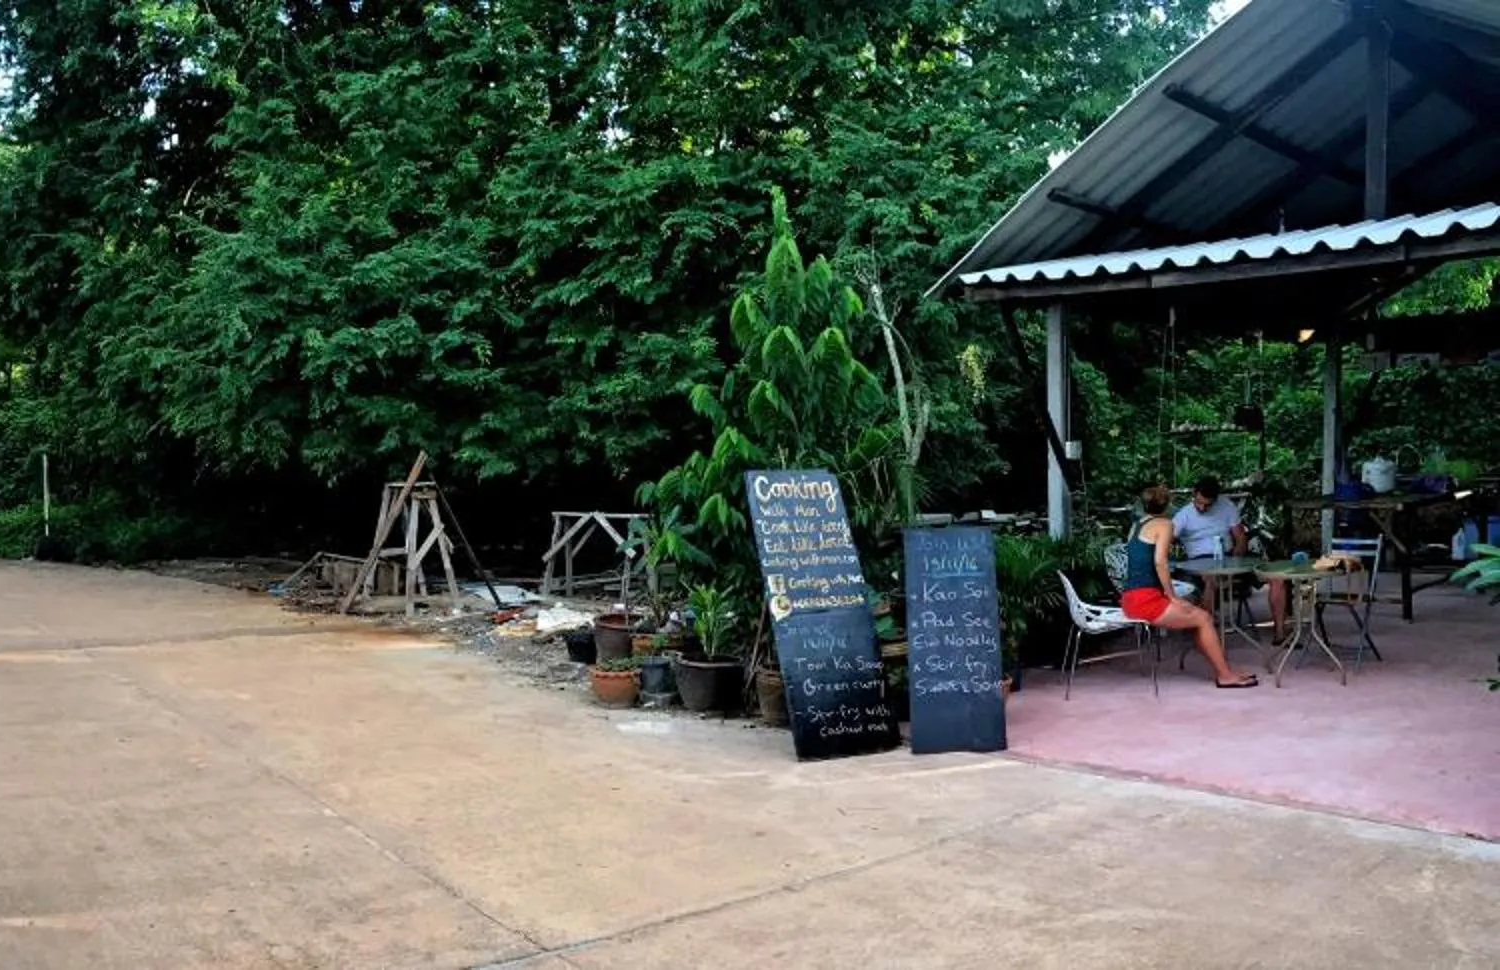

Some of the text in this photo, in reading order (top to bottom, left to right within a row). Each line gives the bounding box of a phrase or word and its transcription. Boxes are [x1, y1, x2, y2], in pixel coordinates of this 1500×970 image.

[754, 475, 839, 513] Cooking
[922, 581, 957, 603] Kao
[920, 611, 955, 629] Pad
